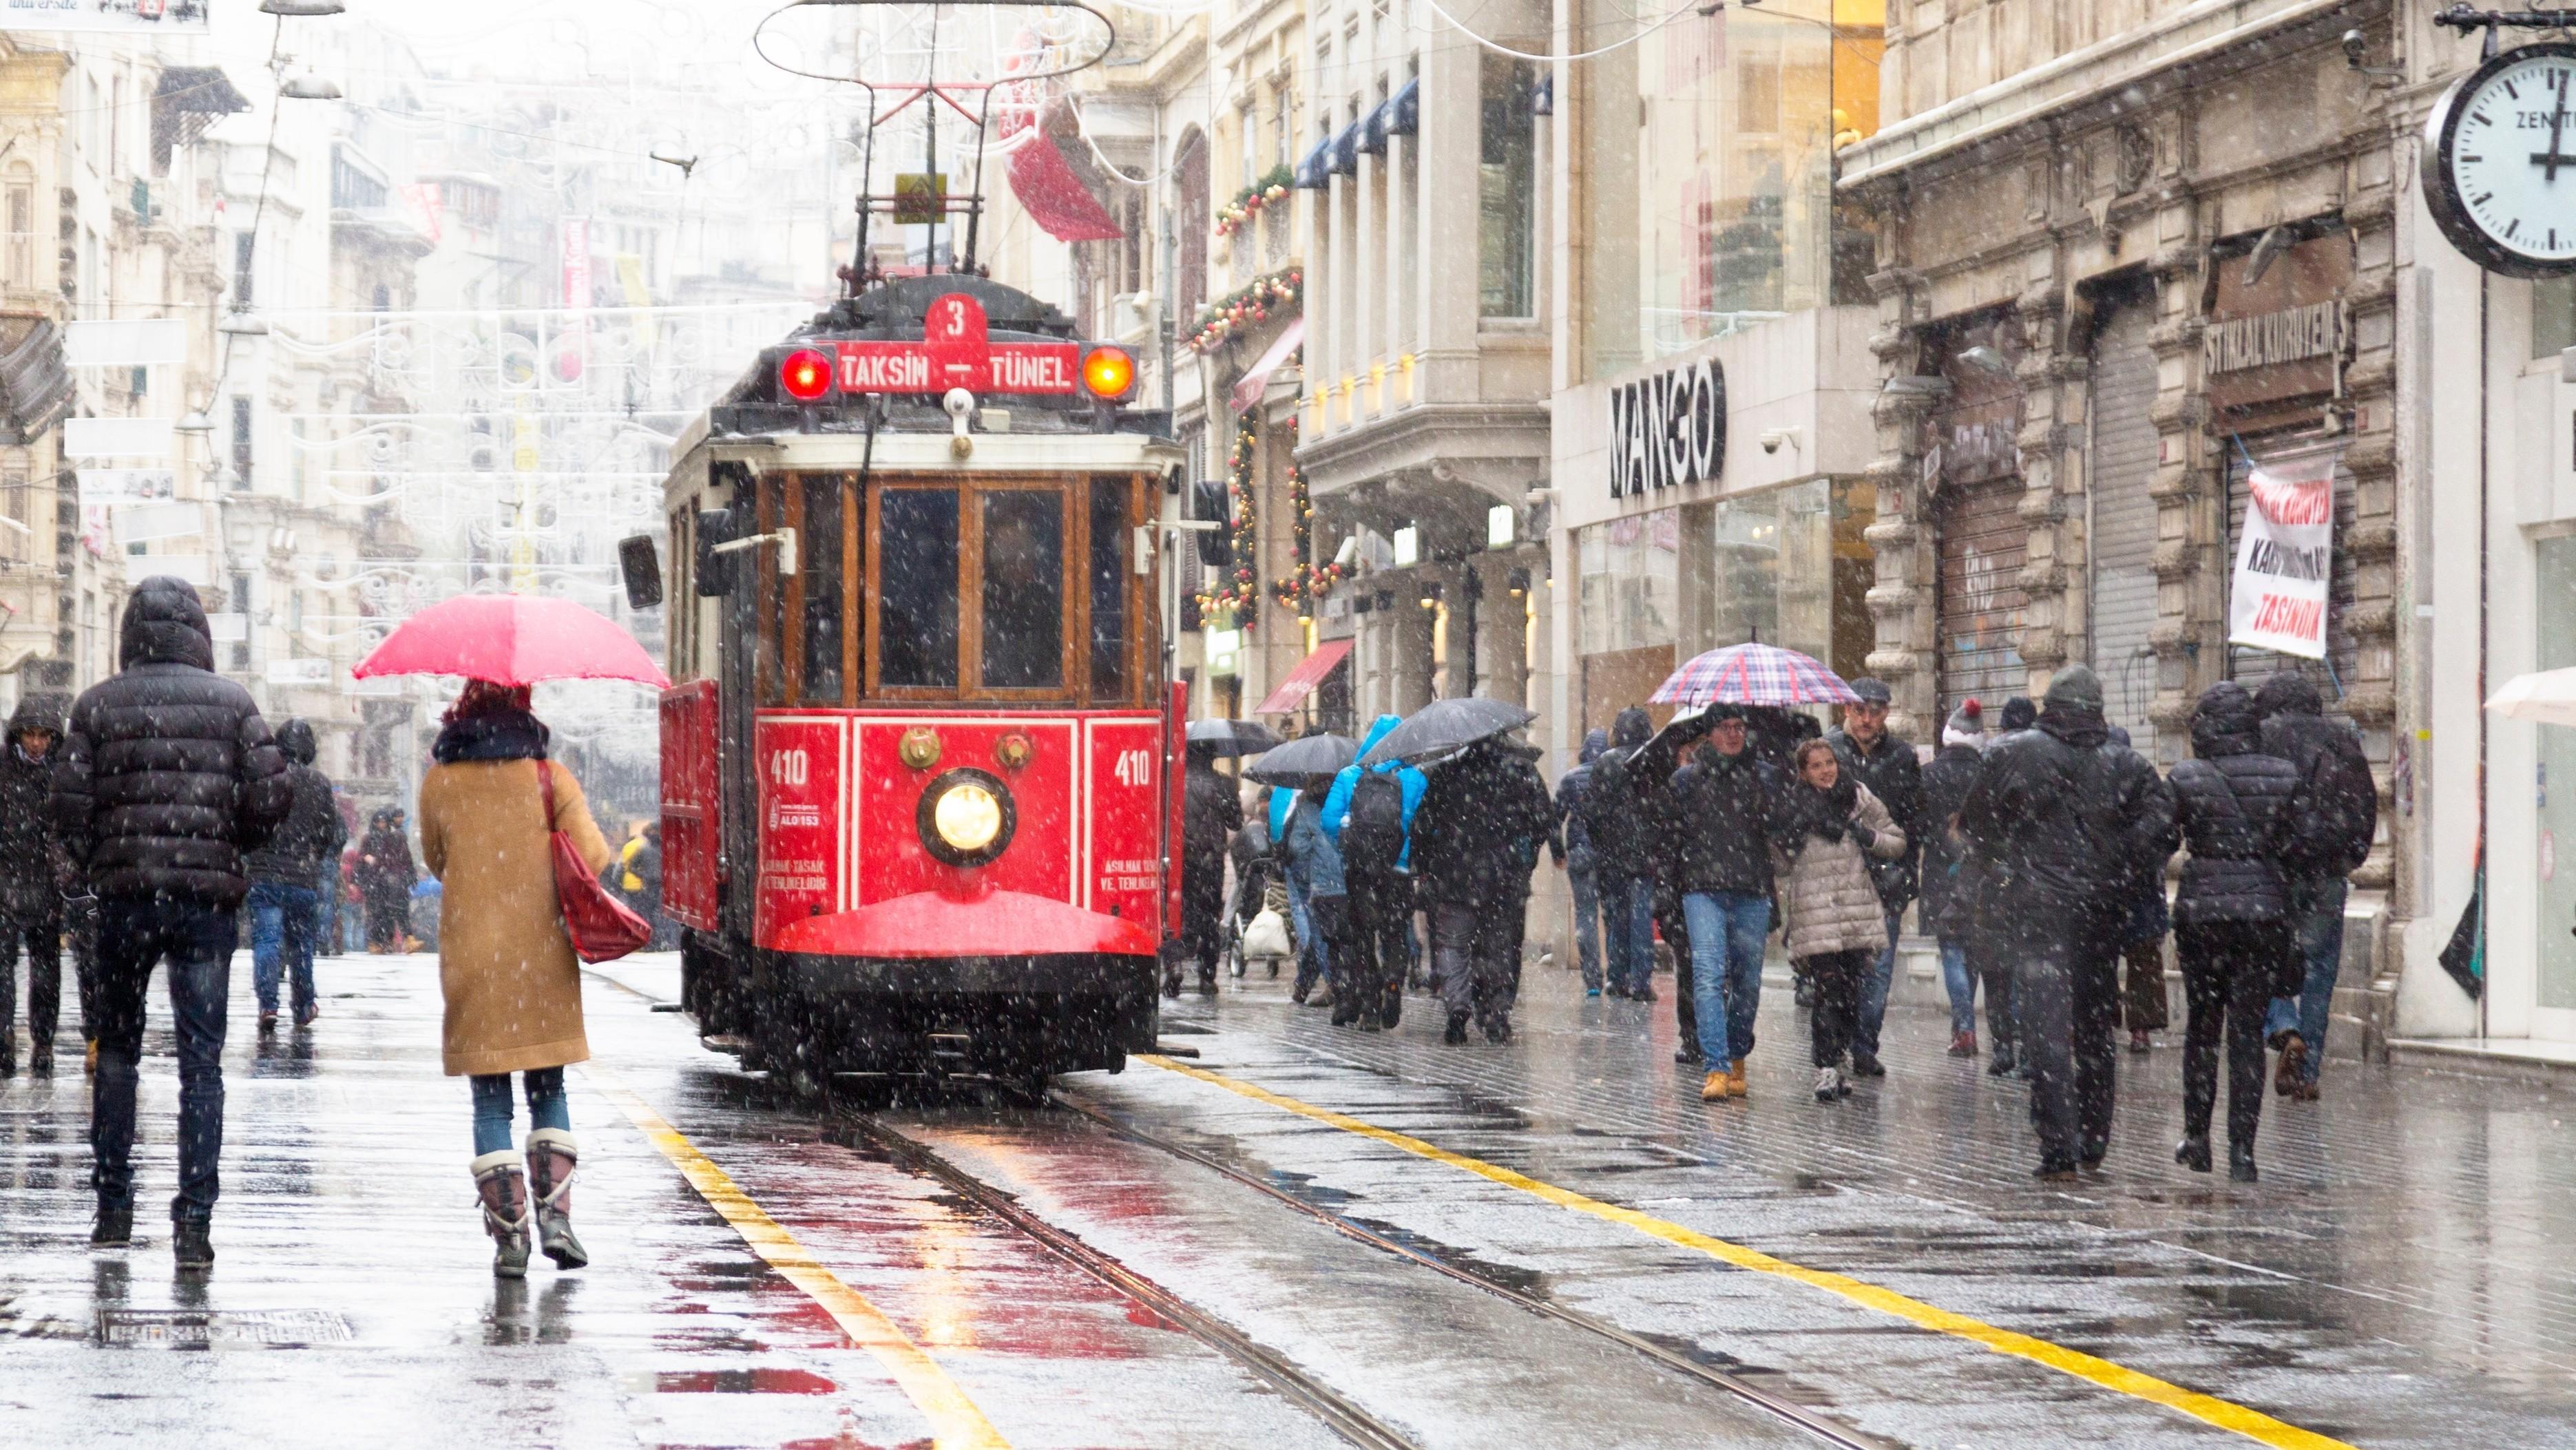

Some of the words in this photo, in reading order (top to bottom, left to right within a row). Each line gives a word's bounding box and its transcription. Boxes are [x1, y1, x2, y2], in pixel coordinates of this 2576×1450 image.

[946, 300, 965, 336] 3
[840, 350, 928, 386] TAKSİM
[989, 351, 1071, 387] TÜNEL
[1607, 355, 1726, 498] MANGO
[771, 749, 807, 785] 410
[1114, 749, 1149, 786] 410
[800, 815, 819, 826] 153
